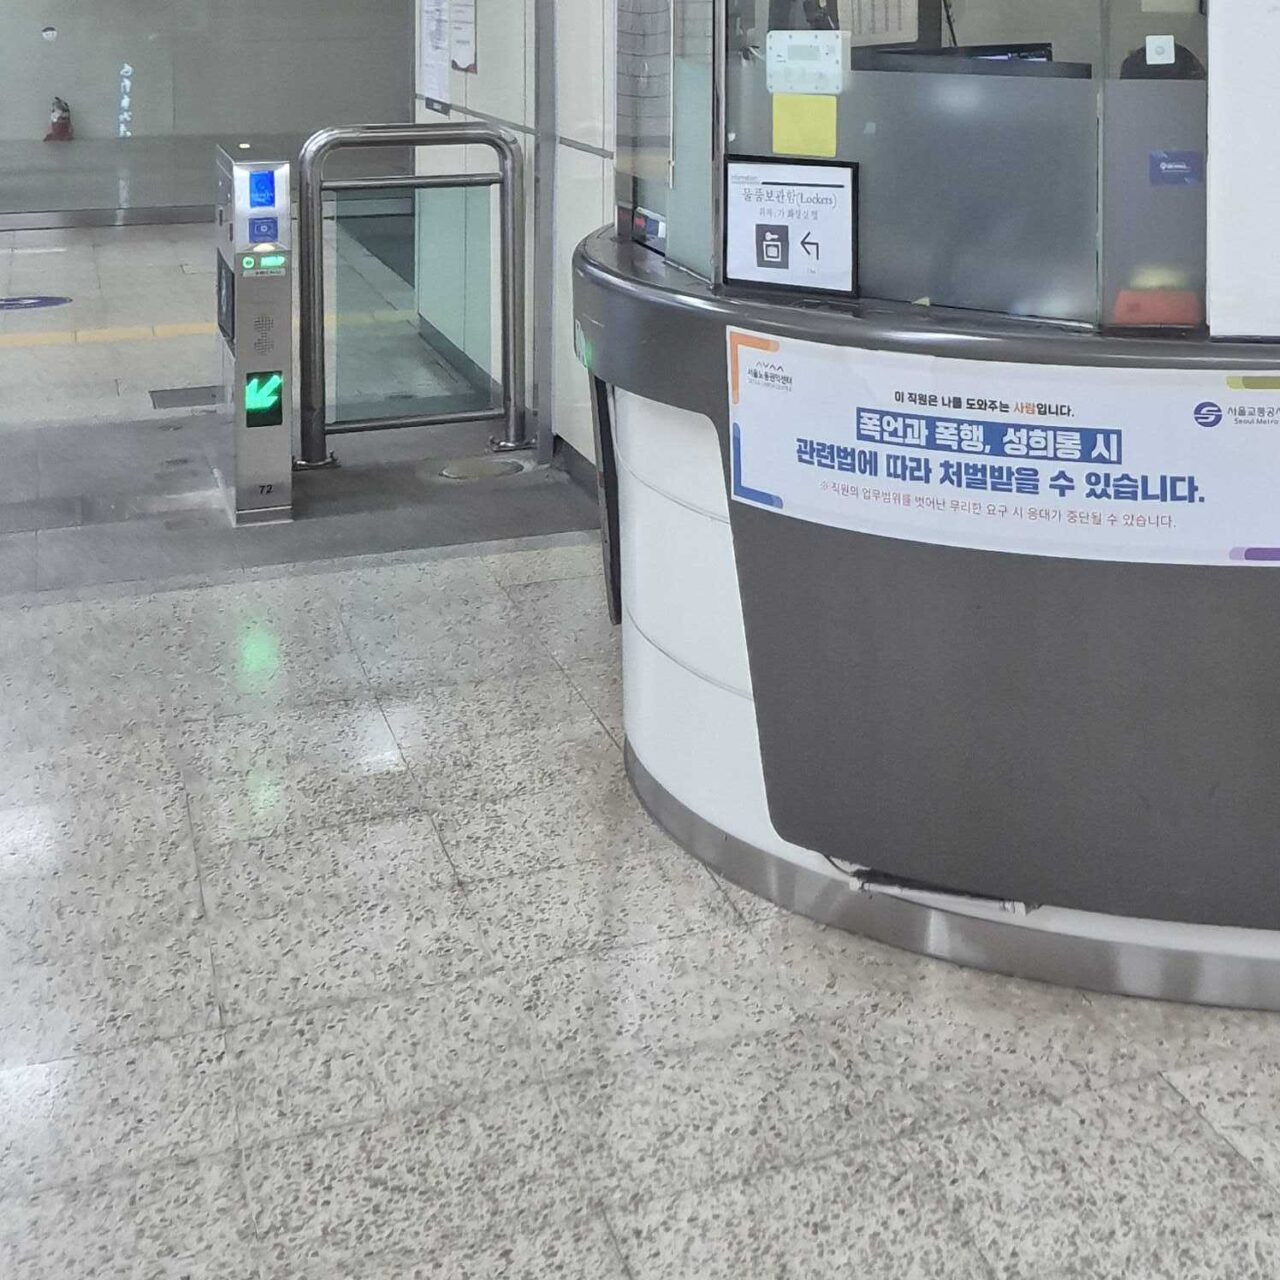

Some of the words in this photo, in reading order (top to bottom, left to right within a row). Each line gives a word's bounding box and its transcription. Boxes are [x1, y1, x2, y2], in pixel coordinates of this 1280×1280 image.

[895, 390, 904, 403] 이
[908, 392, 938, 407] 직원은
[941, 396, 962, 409] 나를
[966, 397, 1010, 413] 도와주는
[1014, 401, 1075, 418] 사람입니다.
[860, 412, 928, 446] 폭언과
[935, 421, 991, 453] 폭행,
[1003, 428, 1082, 460] 성희롱
[1091, 433, 1118, 462] 시
[796, 438, 878, 477] 관련법에
[886, 453, 932, 484] 따라
[939, 460, 1040, 495] 처벌받을
[1049, 470, 1075, 497] 수
[1085, 472, 1205, 503] 있습니다.
[832, 483, 859, 498] 직원의
[862, 487, 911, 507] 업무범위를
[915, 495, 946, 511] 벗어난
[950, 499, 982, 515] 무리한
[986, 504, 1008, 518] 요구
[1013, 506, 1023, 518] 시
[1028, 507, 1062, 523] 응대기
[1067, 510, 1102, 526] 중단될
[1107, 513, 1118, 526] 수
[1123, 513, 1176, 529] 있습니다.
